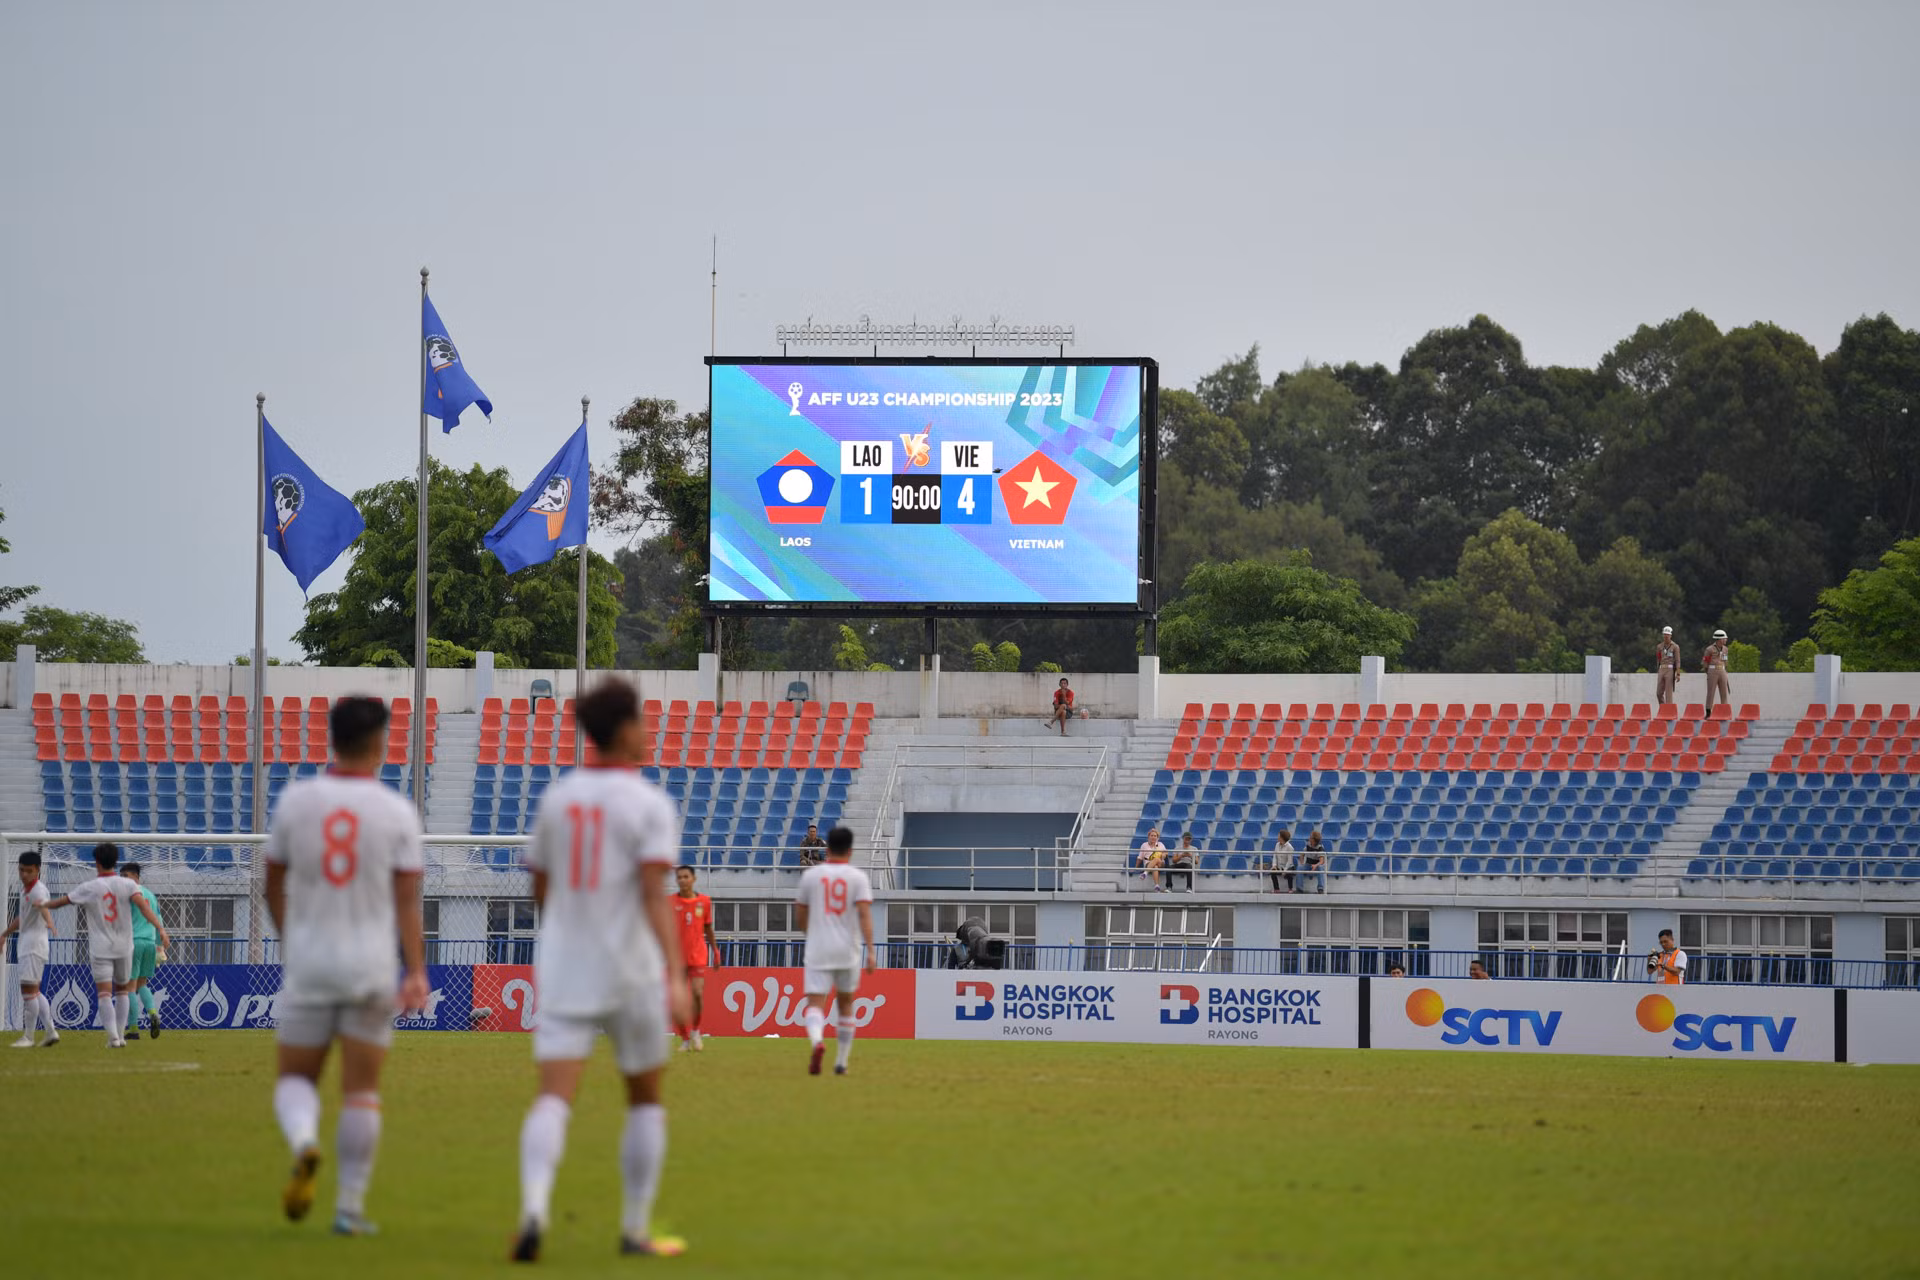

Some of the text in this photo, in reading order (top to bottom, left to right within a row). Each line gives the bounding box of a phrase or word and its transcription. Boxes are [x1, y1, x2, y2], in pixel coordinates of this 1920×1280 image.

[808, 392, 1063, 407] AFF U23 CHAMPIONSHIP 2023
[853, 445, 882, 467] LAO
[900, 433, 931, 467] VS
[954, 445, 980, 468] VIE
[859, 477, 872, 515] 1
[892, 485, 942, 510] 90:00
[957, 477, 976, 515] 4
[779, 537, 812, 547] LAOS
[1009, 539, 1065, 549] VIETNAM
[322, 808, 359, 888] 8
[566, 802, 605, 891] 11
[102, 891, 119, 923] 3
[821, 876, 848, 916] 19
[723, 976, 886, 1032] Vio
[1003, 984, 1115, 1002] BANGKOK
[1208, 987, 1321, 1006] BANGKOK
[1003, 1002, 1115, 1020] HOSPITAL
[1208, 1006, 1321, 1025] HOSPITAL
[394, 1017, 437, 1029] Group
[1003, 1025, 1053, 1036] RAYONG
[1208, 1029, 1259, 1040] RAYONG
[1440, 1007, 1563, 1046] SCTV
[1672, 1013, 1797, 1052] SCTV
